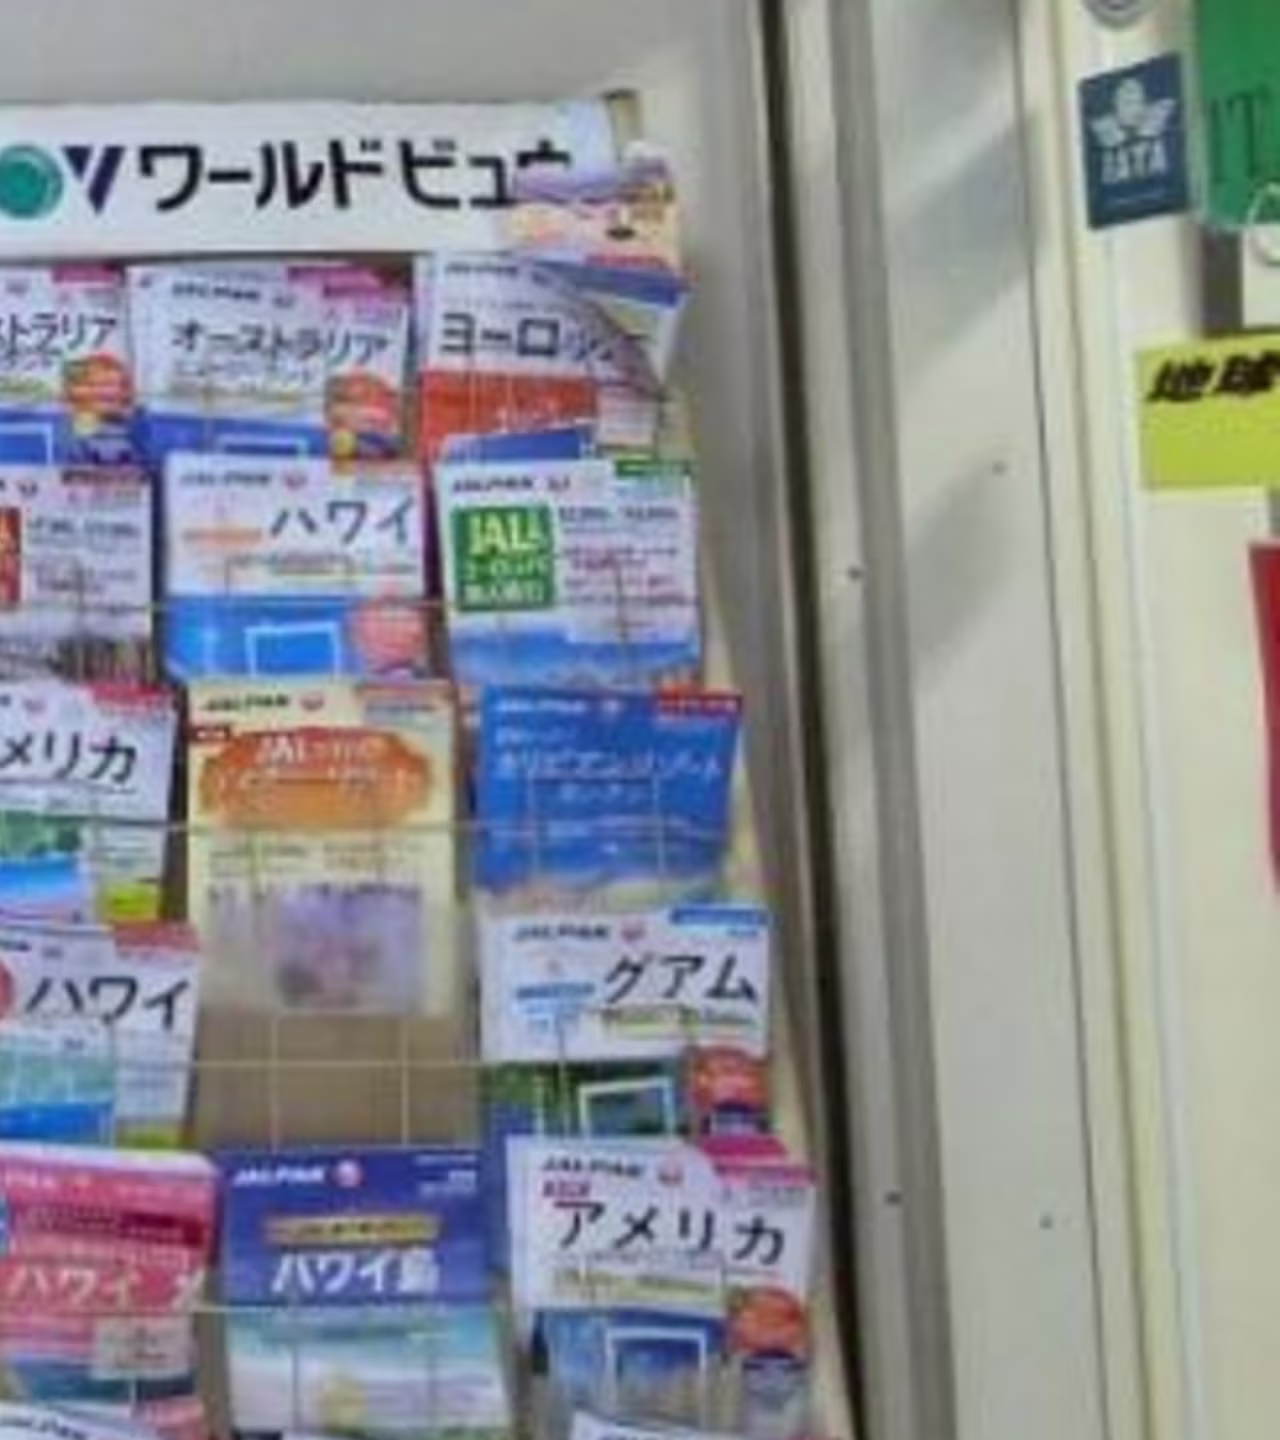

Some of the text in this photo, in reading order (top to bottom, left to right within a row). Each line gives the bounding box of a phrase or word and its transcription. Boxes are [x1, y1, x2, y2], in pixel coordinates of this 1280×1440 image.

[1100, 141, 1168, 184] IATA
[171, 318, 389, 364] オーストラリア
[269, 497, 418, 546] ハワイ
[24, 974, 191, 1032] ハワイ
[603, 953, 759, 1006] グアム
[552, 1199, 787, 1268] アメリカ
[7, 1263, 142, 1300] ハワイ
[270, 1247, 441, 1294] ハワイ島
